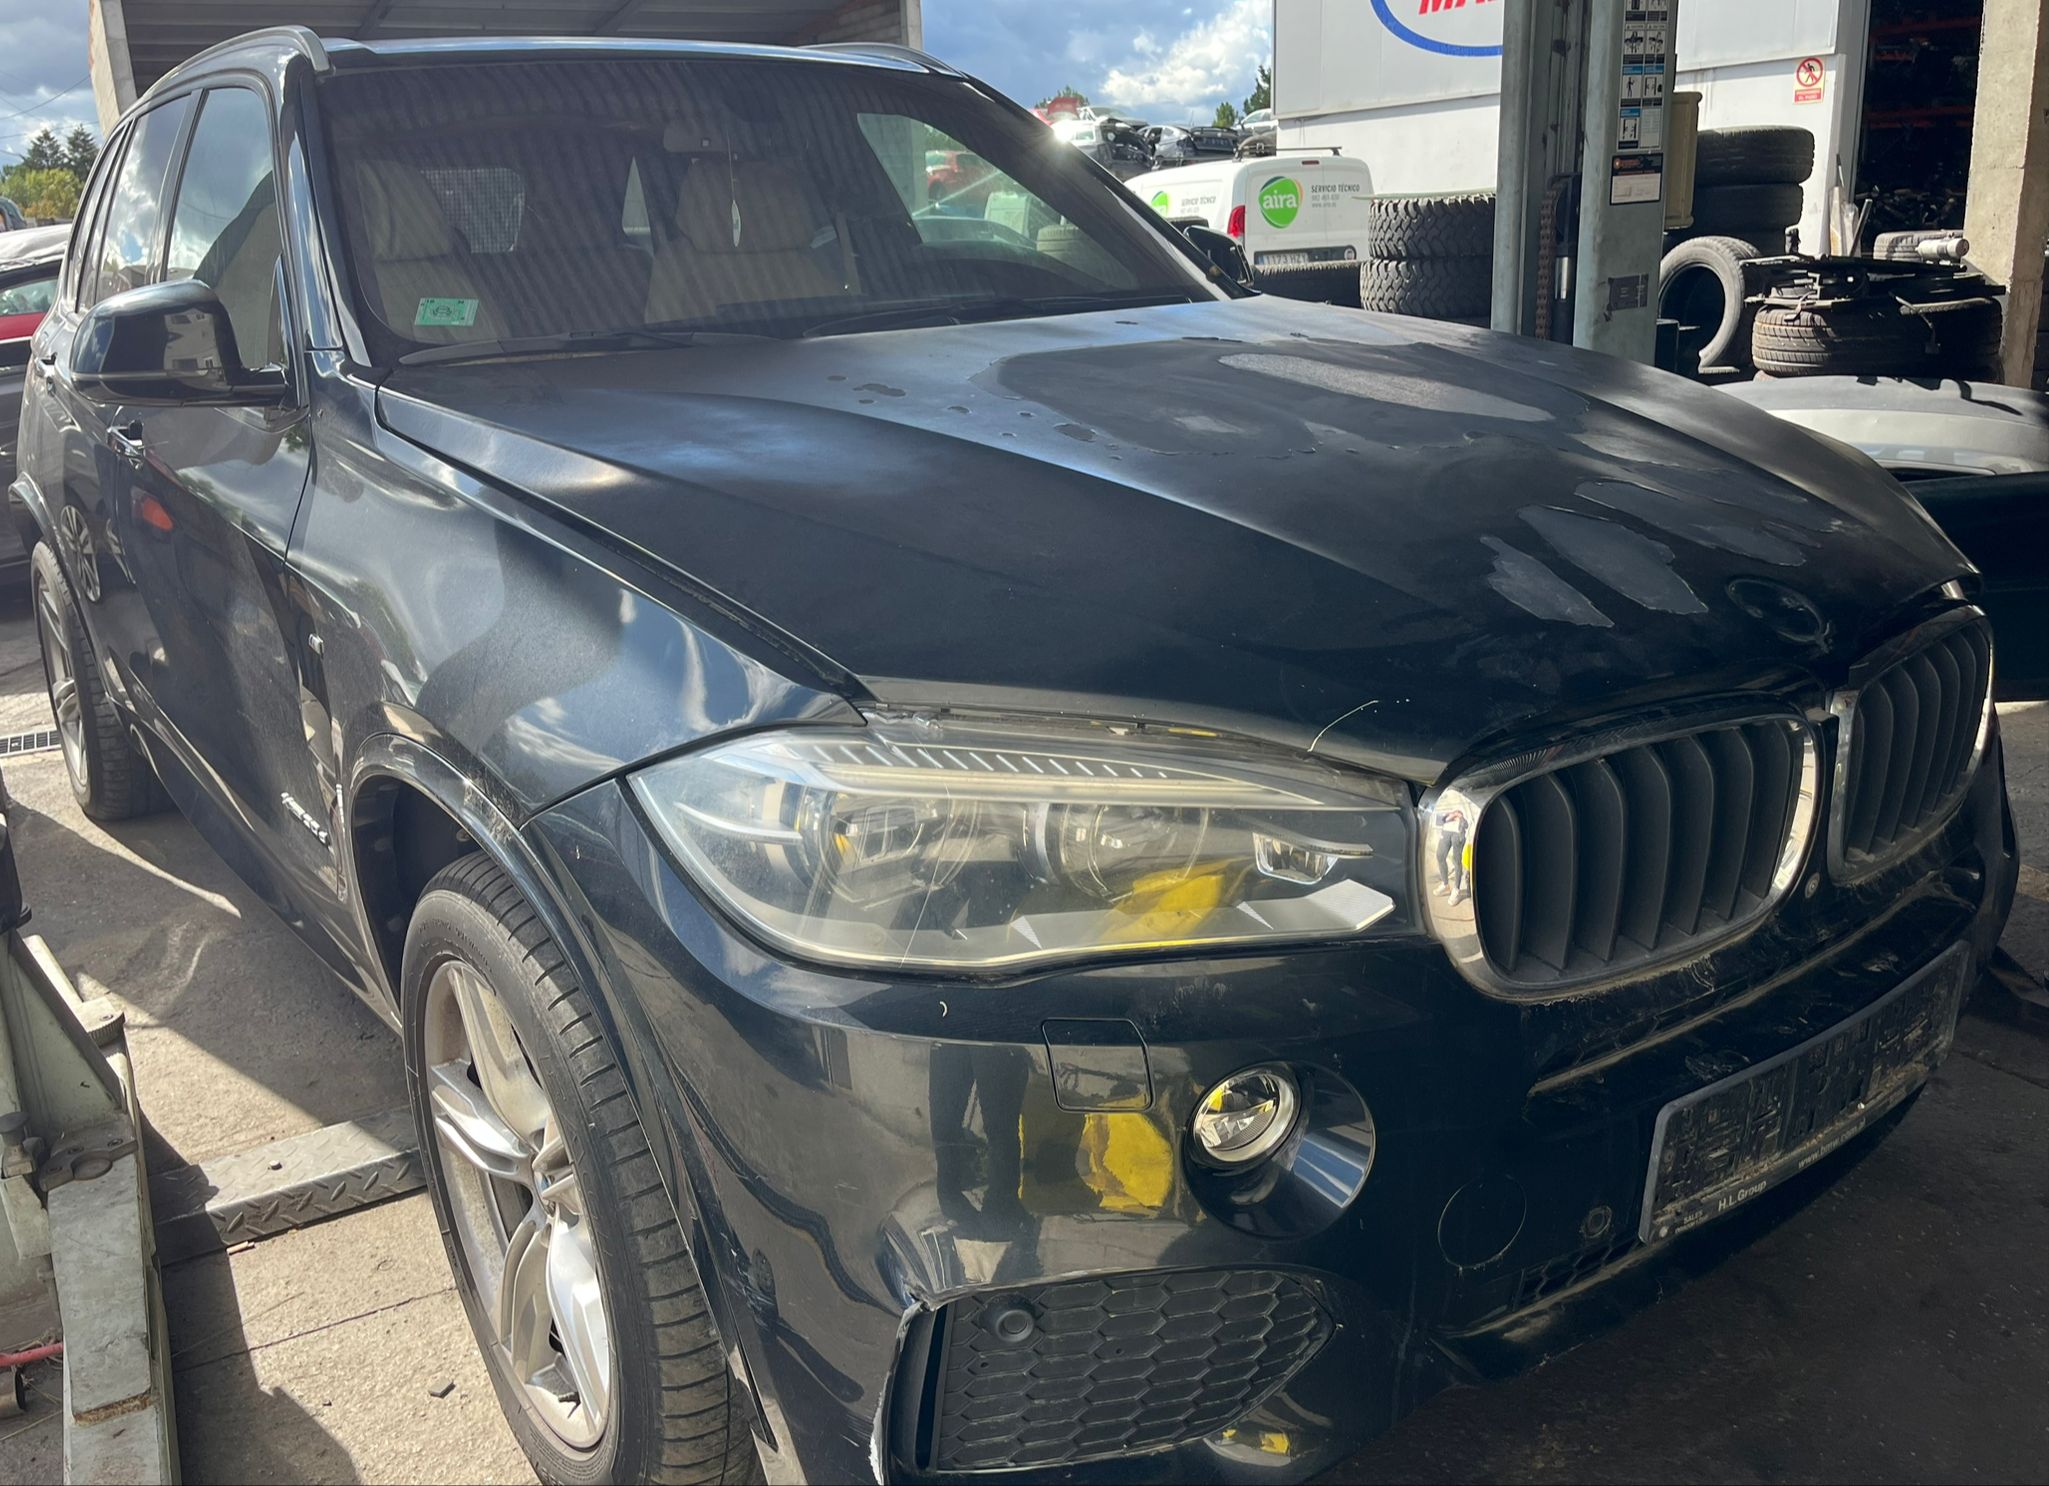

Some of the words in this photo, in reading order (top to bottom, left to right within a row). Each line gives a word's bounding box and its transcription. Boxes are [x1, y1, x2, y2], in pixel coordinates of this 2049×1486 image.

[1311, 184, 1337, 193] SERVICIO
[1338, 182, 1360, 193] TÉCNICO
[1263, 190, 1298, 209] aira
